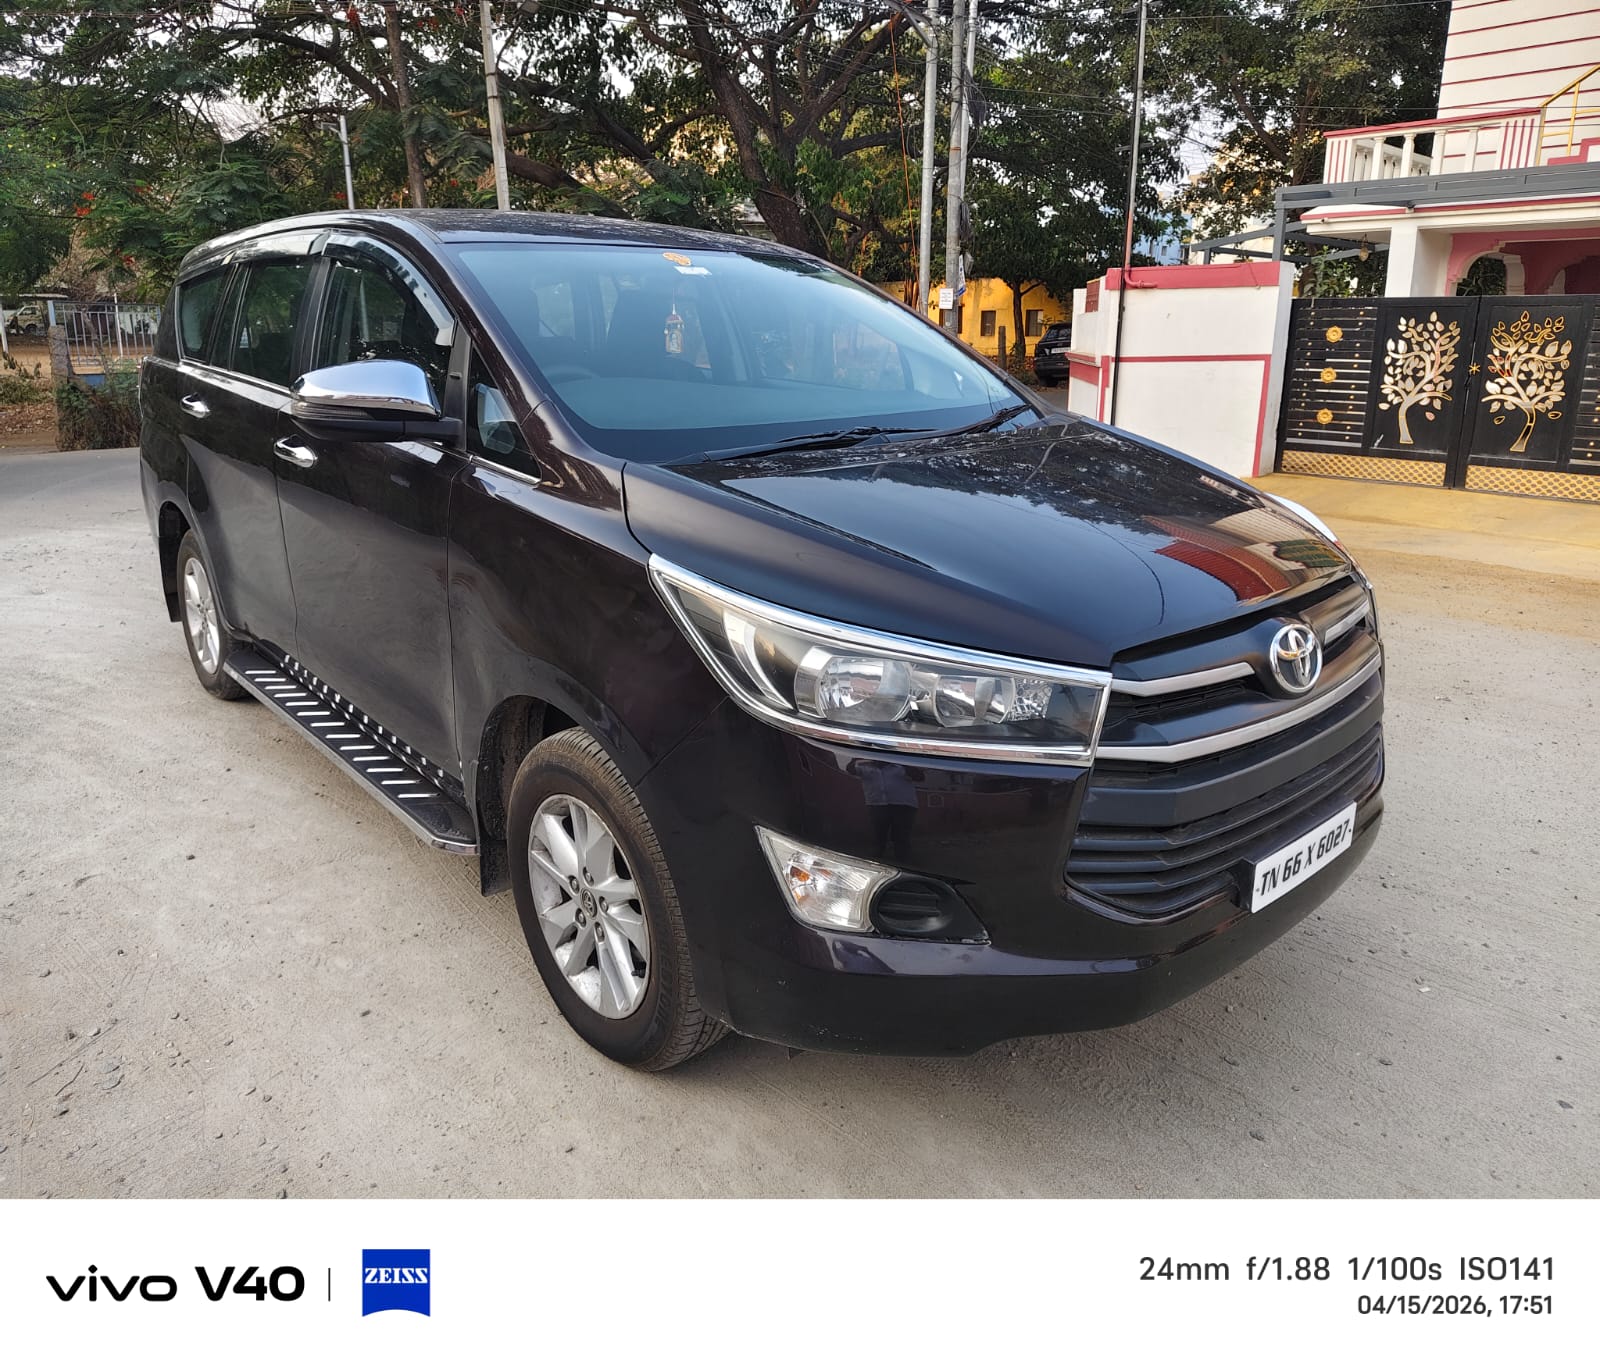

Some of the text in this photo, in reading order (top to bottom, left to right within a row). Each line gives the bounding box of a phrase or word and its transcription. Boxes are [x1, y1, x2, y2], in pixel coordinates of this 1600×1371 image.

[1260, 818, 1350, 896] TN 66 X 6027
